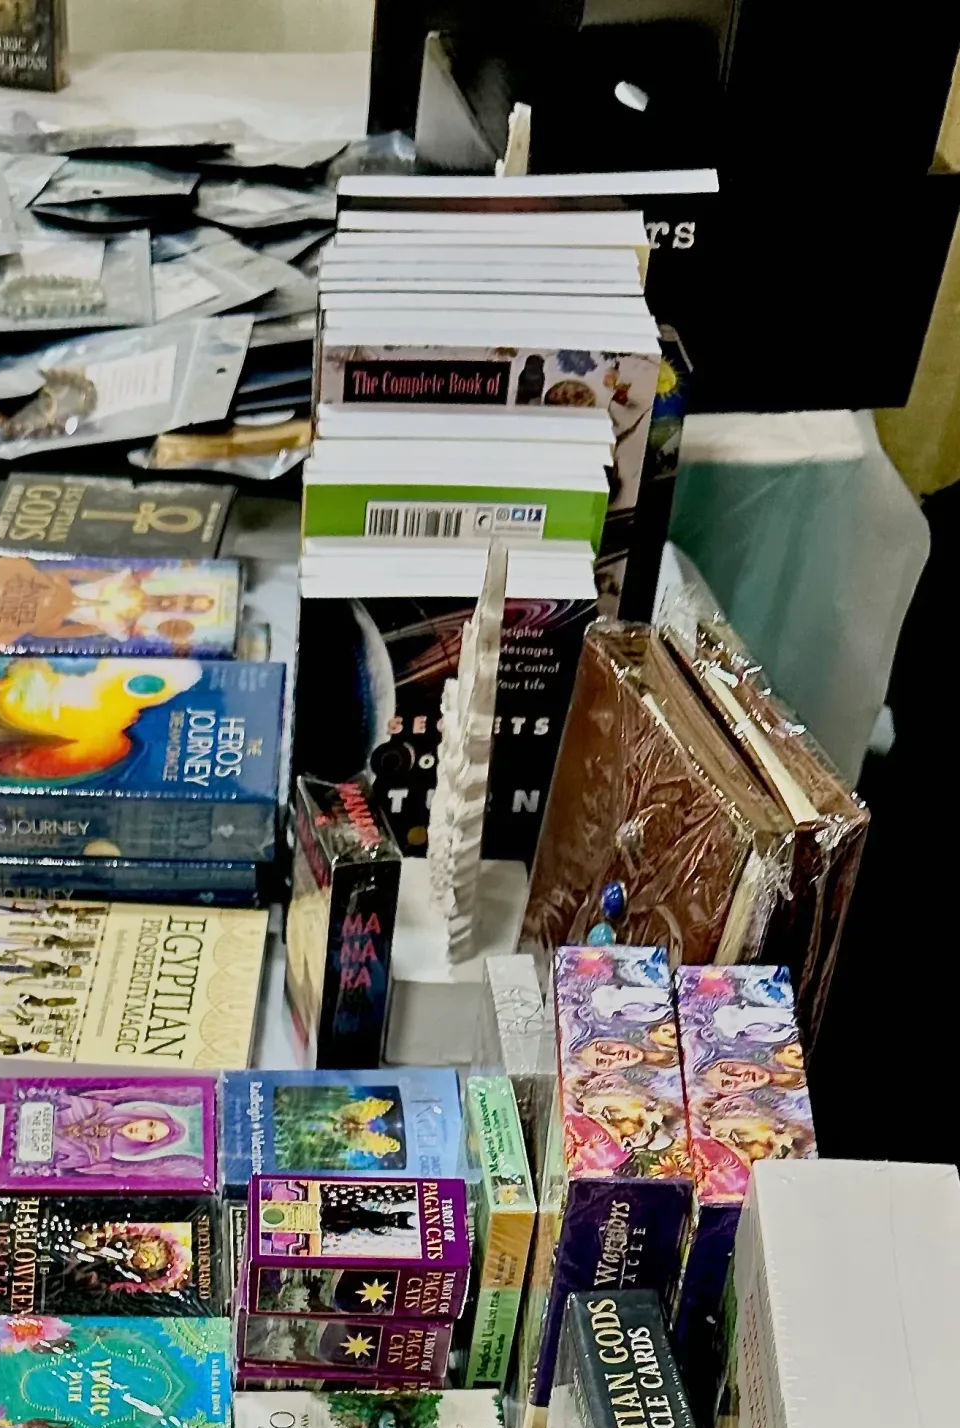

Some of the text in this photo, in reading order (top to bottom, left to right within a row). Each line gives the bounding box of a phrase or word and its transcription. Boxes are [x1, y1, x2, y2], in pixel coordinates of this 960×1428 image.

[351, 371, 502, 397] The Complete Book of
[183, 706, 217, 787] JOURNEY
[9, 819, 91, 839] JOURNEY
[342, 912, 381, 935] MA
[140, 915, 208, 1060] EGYPTIAN
[340, 966, 372, 990] RA
[422, 1182, 440, 1226] PAGAN
[432, 1229, 443, 1260] CATS
[441, 1197, 456, 1242] TAROT OF
[404, 1277, 423, 1309] CATS
[422, 1271, 443, 1315] PAGAN
[442, 1271, 456, 1301] TAROT
[387, 1333, 405, 1364] CATS
[404, 1329, 423, 1370] PAGAN
[587, 1297, 630, 1369] GODS
[633, 1326, 665, 1389] CARDS
